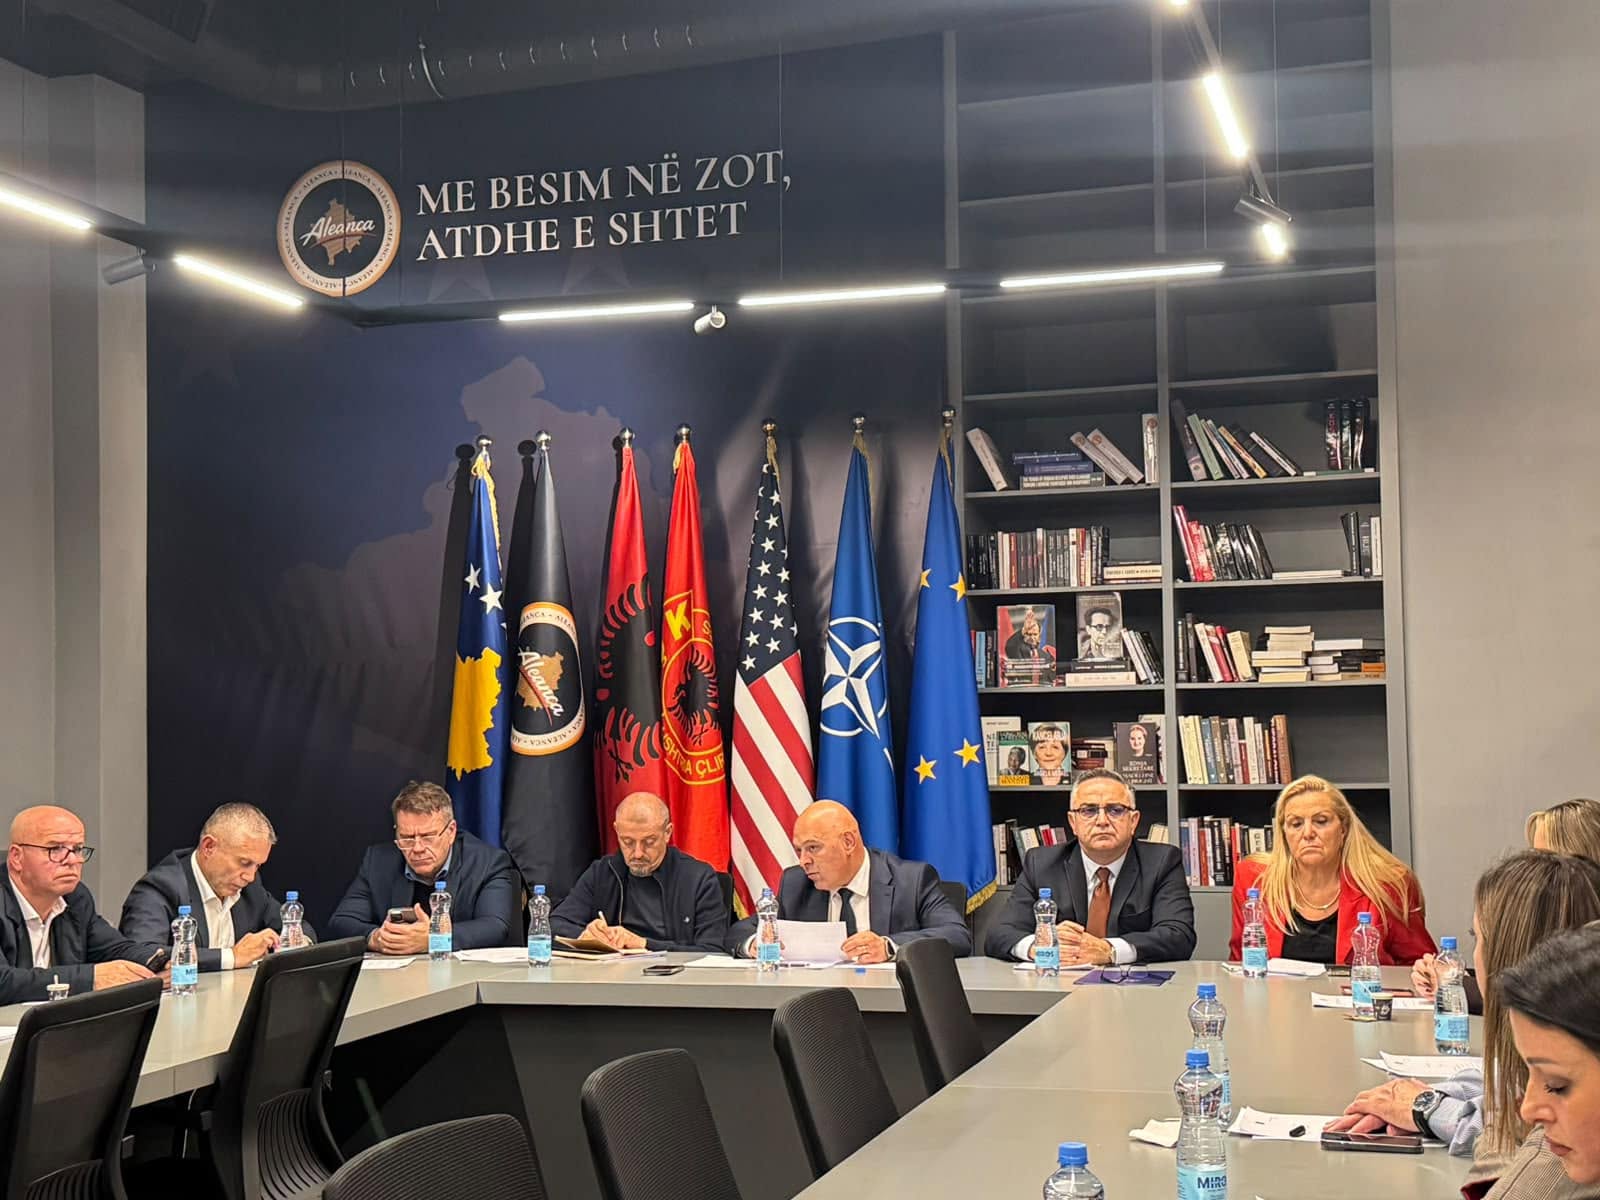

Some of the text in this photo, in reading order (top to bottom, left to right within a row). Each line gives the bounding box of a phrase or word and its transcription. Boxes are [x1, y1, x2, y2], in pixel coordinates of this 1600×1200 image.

[416, 149, 791, 216] ME BESIM NË ZOT,
[299, 215, 376, 247] Aleanca
[416, 201, 748, 262] ATDHE E SHTET
[517, 645, 566, 718] Aleanca
